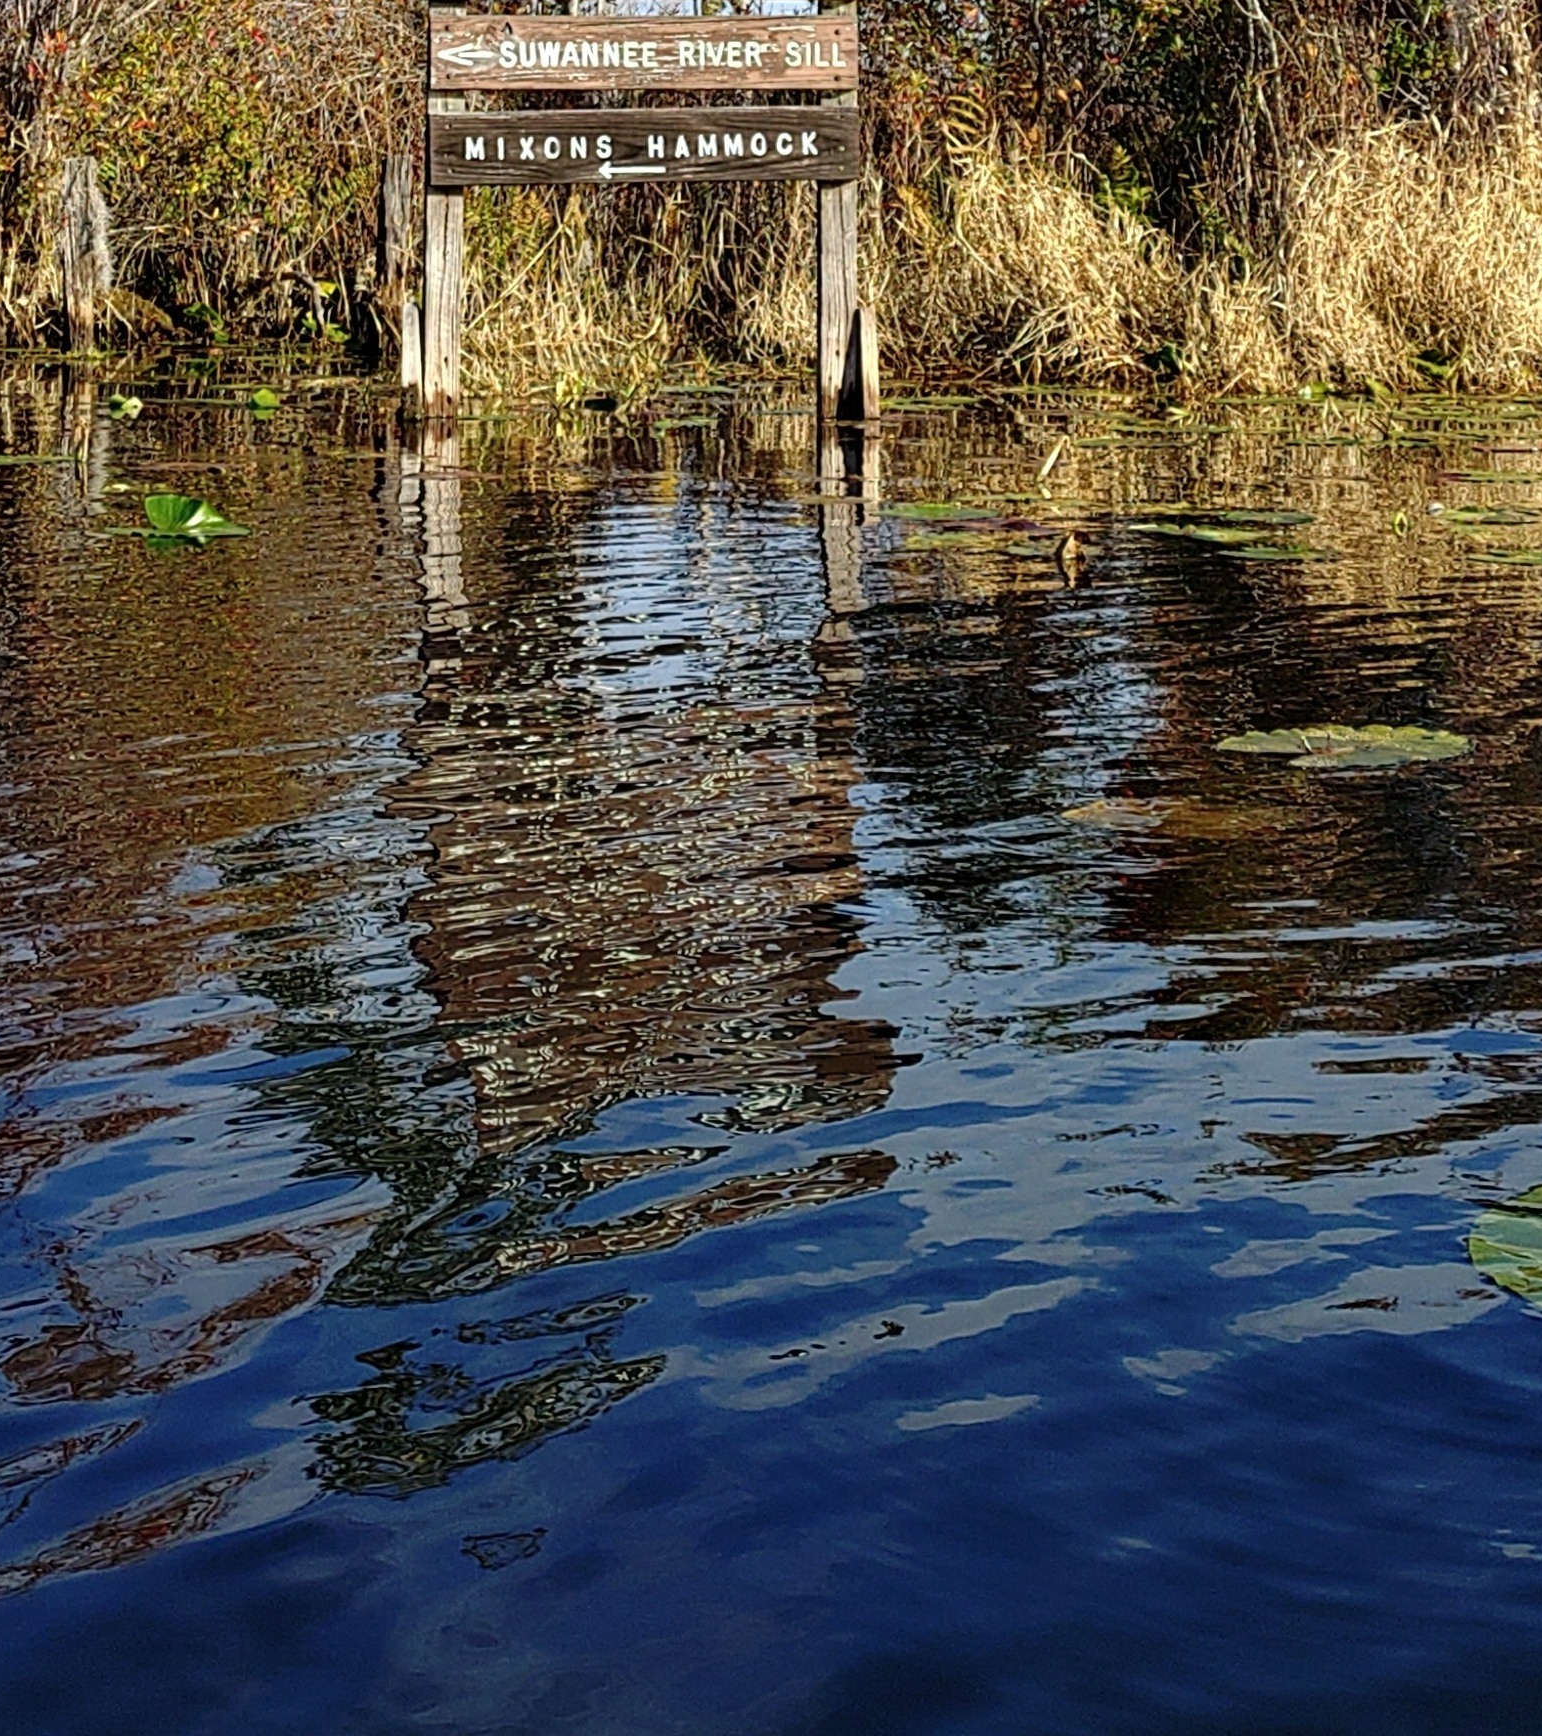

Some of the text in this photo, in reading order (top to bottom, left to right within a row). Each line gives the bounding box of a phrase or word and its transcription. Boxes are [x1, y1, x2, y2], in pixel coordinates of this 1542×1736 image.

[498, 41, 846, 68] SUWANNEE RIVER SILL
[465, 131, 819, 161] MIXONS HAMMOCK
